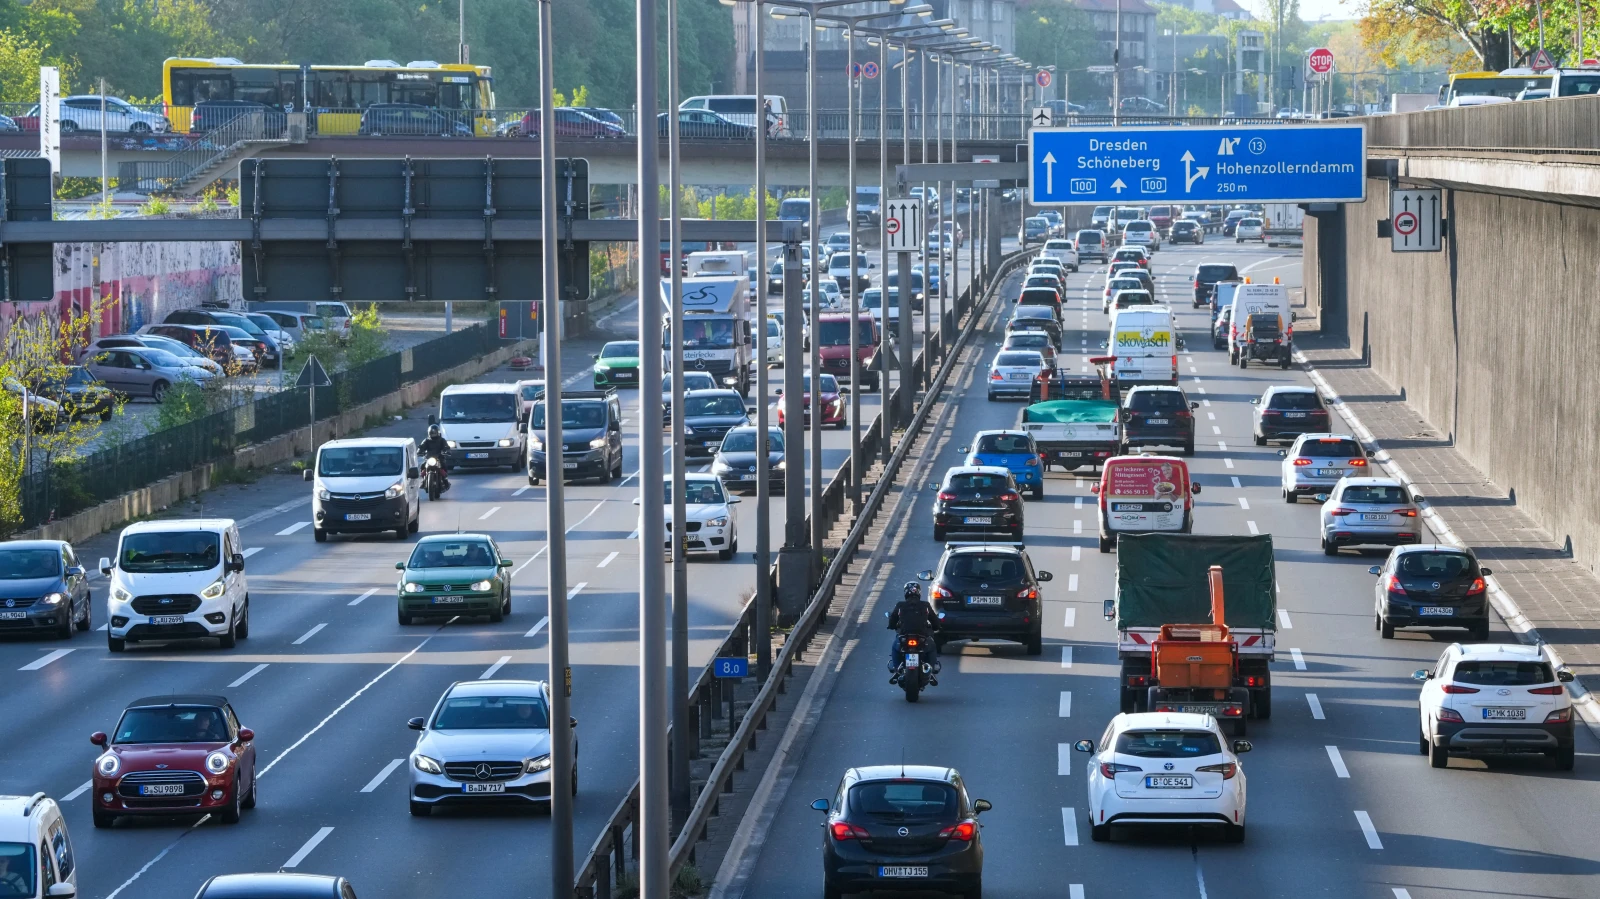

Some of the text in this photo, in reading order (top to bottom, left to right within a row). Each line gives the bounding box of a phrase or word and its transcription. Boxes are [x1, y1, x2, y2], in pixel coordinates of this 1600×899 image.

[1311, 55, 1332, 66] STOP
[1089, 139, 1148, 151] Dresden
[1251, 141, 1263, 151] 13
[1077, 155, 1161, 171] Schöneberg
[1217, 161, 1355, 175] Hohenzollerndamm
[1074, 180, 1092, 192] 100
[1145, 180, 1162, 191] 100
[1217, 183, 1236, 193] 250
[1118, 334, 1169, 348] skowasch
[1507, 709, 1524, 717] 1038
[165, 785, 182, 793] 9898
[914, 867, 928, 876] 155
